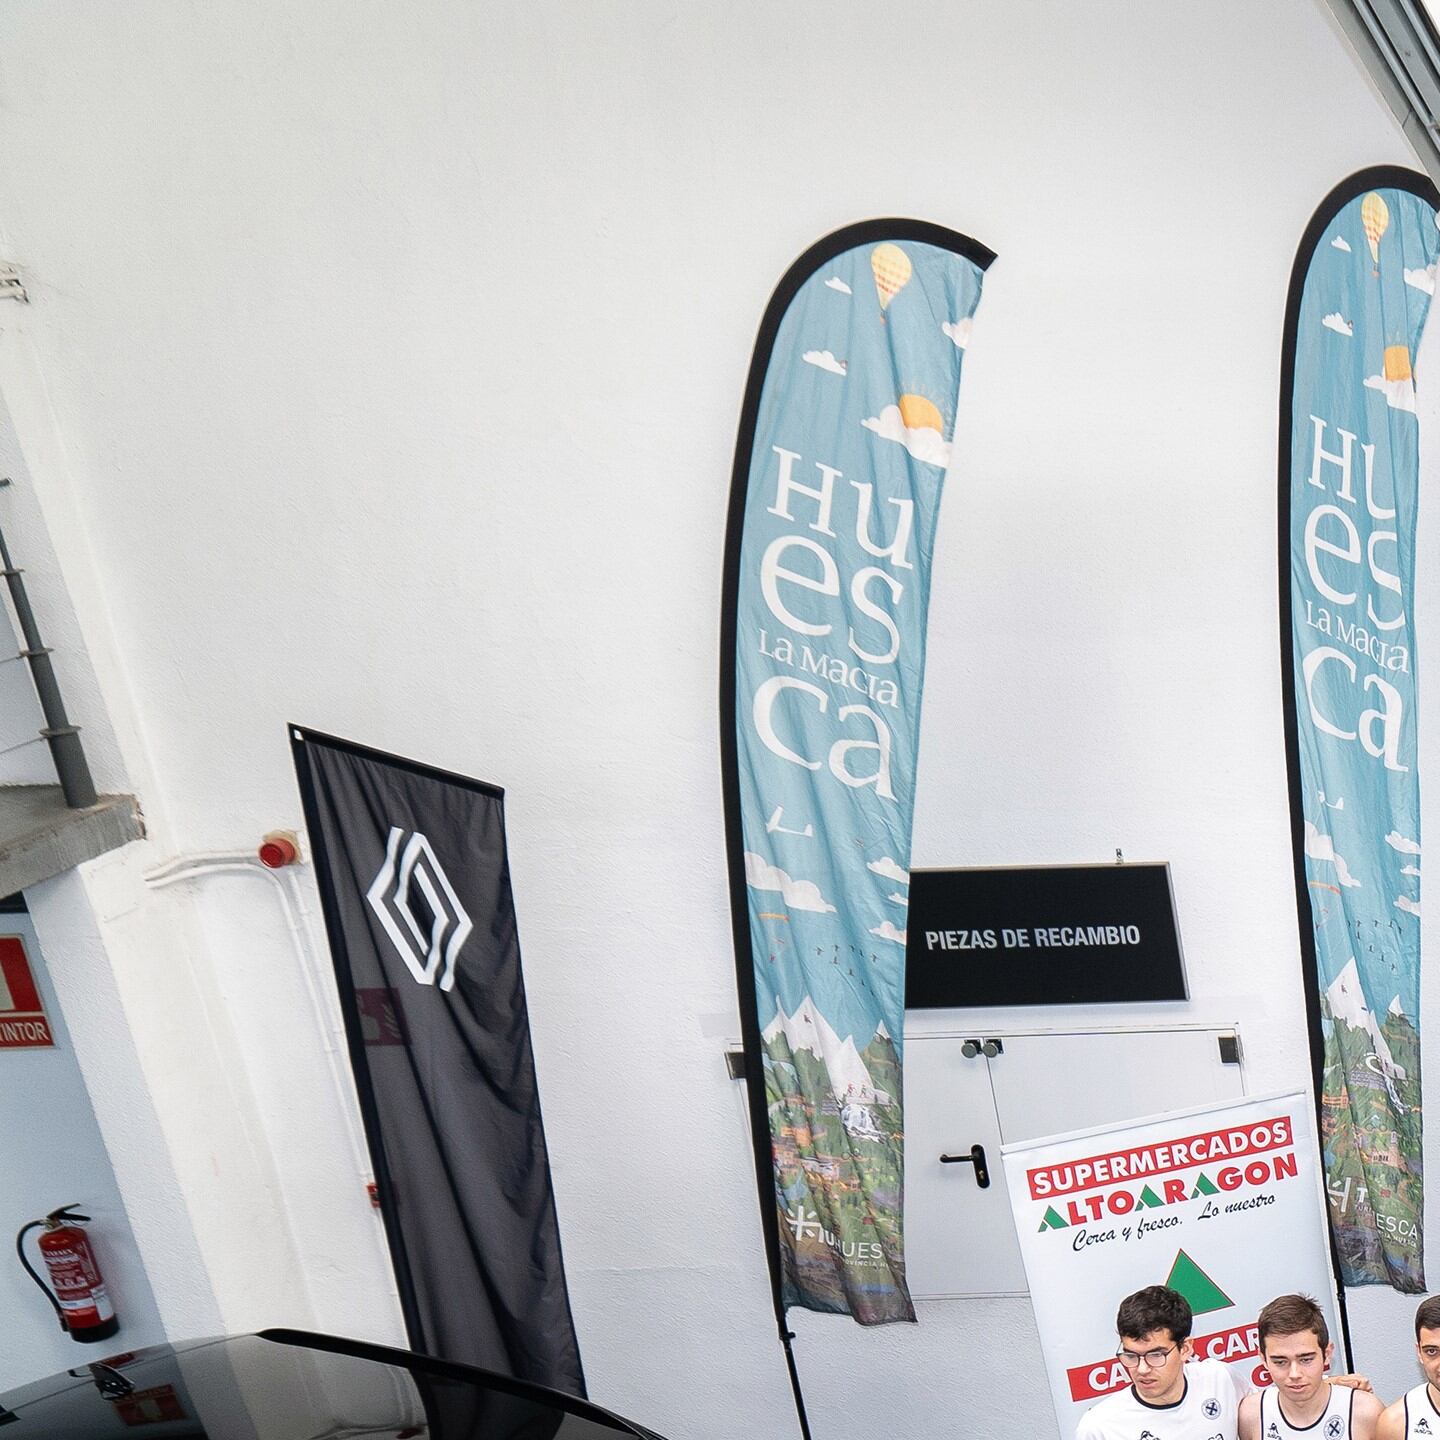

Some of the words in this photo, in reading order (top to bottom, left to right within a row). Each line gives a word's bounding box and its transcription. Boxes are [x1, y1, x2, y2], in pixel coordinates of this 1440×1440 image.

[758, 531, 906, 668] es
[1303, 502, 1406, 632] es
[925, 927, 1000, 952] PIEZAS
[1003, 926, 1031, 949] DE
[1035, 923, 1142, 949] RECAMBIO
[1033, 1121, 1289, 1196] SUPERMERCADOS
[1038, 1153, 1299, 1233] ALTOARAGON
[1072, 1228, 1117, 1252] Cerca
[1122, 1224, 1133, 1241] y
[1136, 1216, 1184, 1240] fresco.
[1197, 1201, 1220, 1221] Lo
[1224, 1194, 1277, 1216] nuestro
